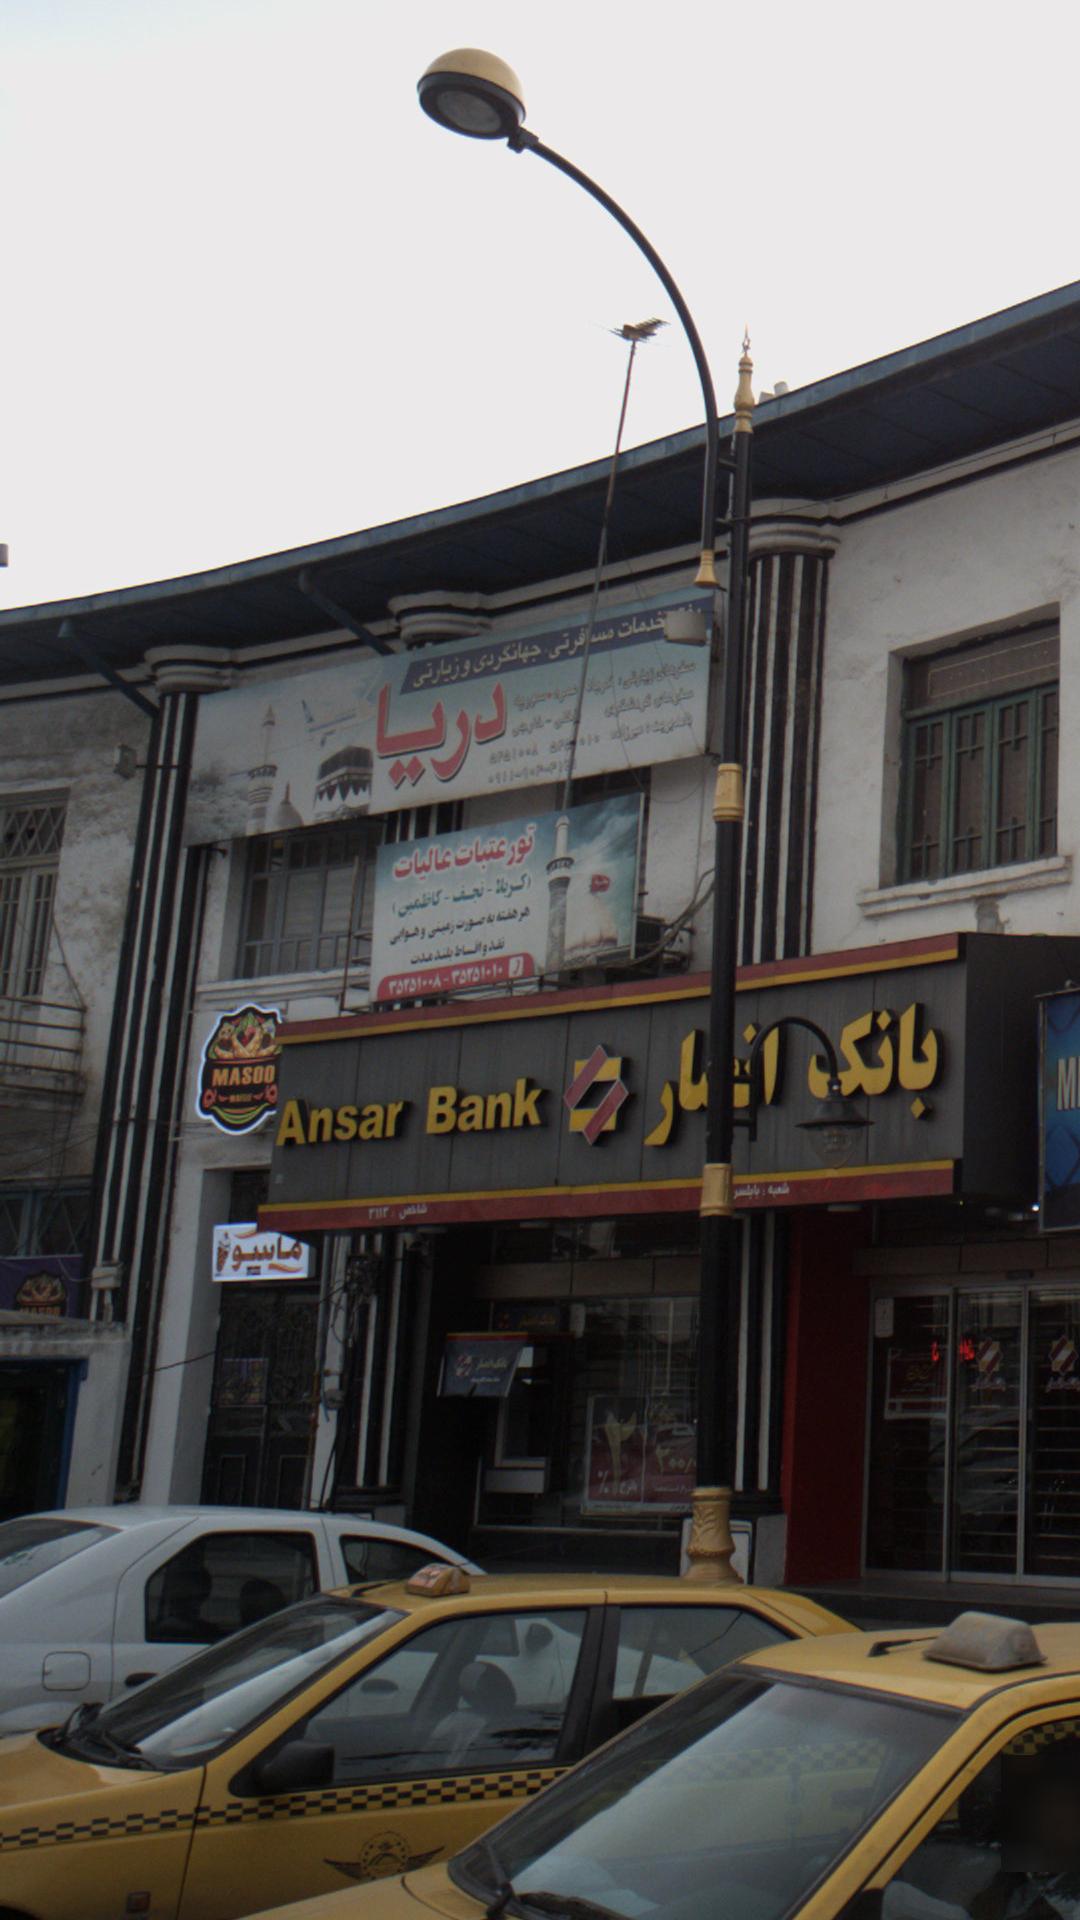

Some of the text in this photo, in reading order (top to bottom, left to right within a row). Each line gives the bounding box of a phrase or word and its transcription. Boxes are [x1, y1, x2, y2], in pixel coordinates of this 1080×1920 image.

[618, 611, 665, 640] خدمات
[412, 657, 460, 688] زیارتی
[460, 659, 470, 676] و
[473, 640, 541, 674] جهانگردی
[376, 682, 507, 790] دریا
[394, 823, 536, 880] تور عتبات عالیات
[212, 1064, 276, 1087] MASOO
[808, 1003, 938, 1120] بانک
[1056, 1056, 1080, 1112] M
[276, 1078, 544, 1147] Ansar Bank
